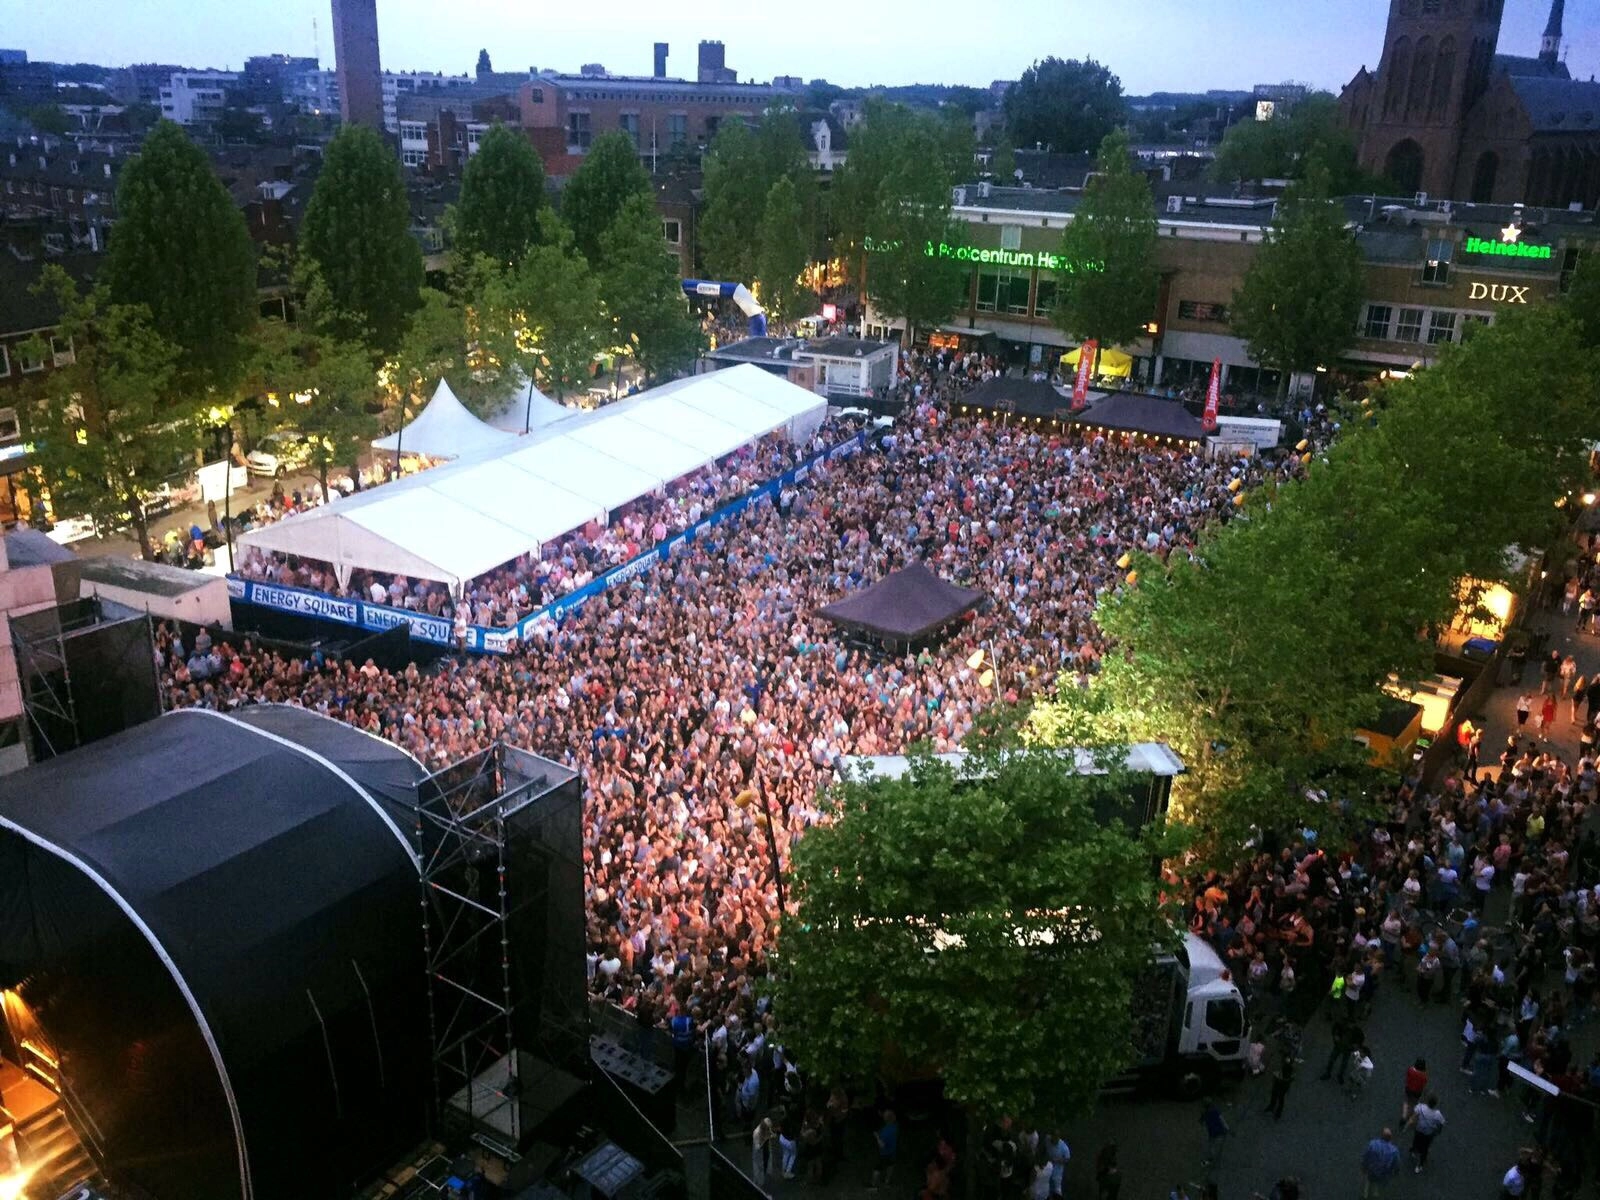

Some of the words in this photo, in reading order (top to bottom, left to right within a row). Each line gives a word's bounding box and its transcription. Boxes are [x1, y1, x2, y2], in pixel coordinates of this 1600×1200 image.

[1465, 237, 1551, 259] Heineken
[1469, 282, 1530, 304] DUX
[1206, 376, 1220, 414] Jupiler
[254, 587, 300, 609] ENERGY
[303, 597, 355, 619] SQUARE
[419, 621, 474, 646] SQUE
